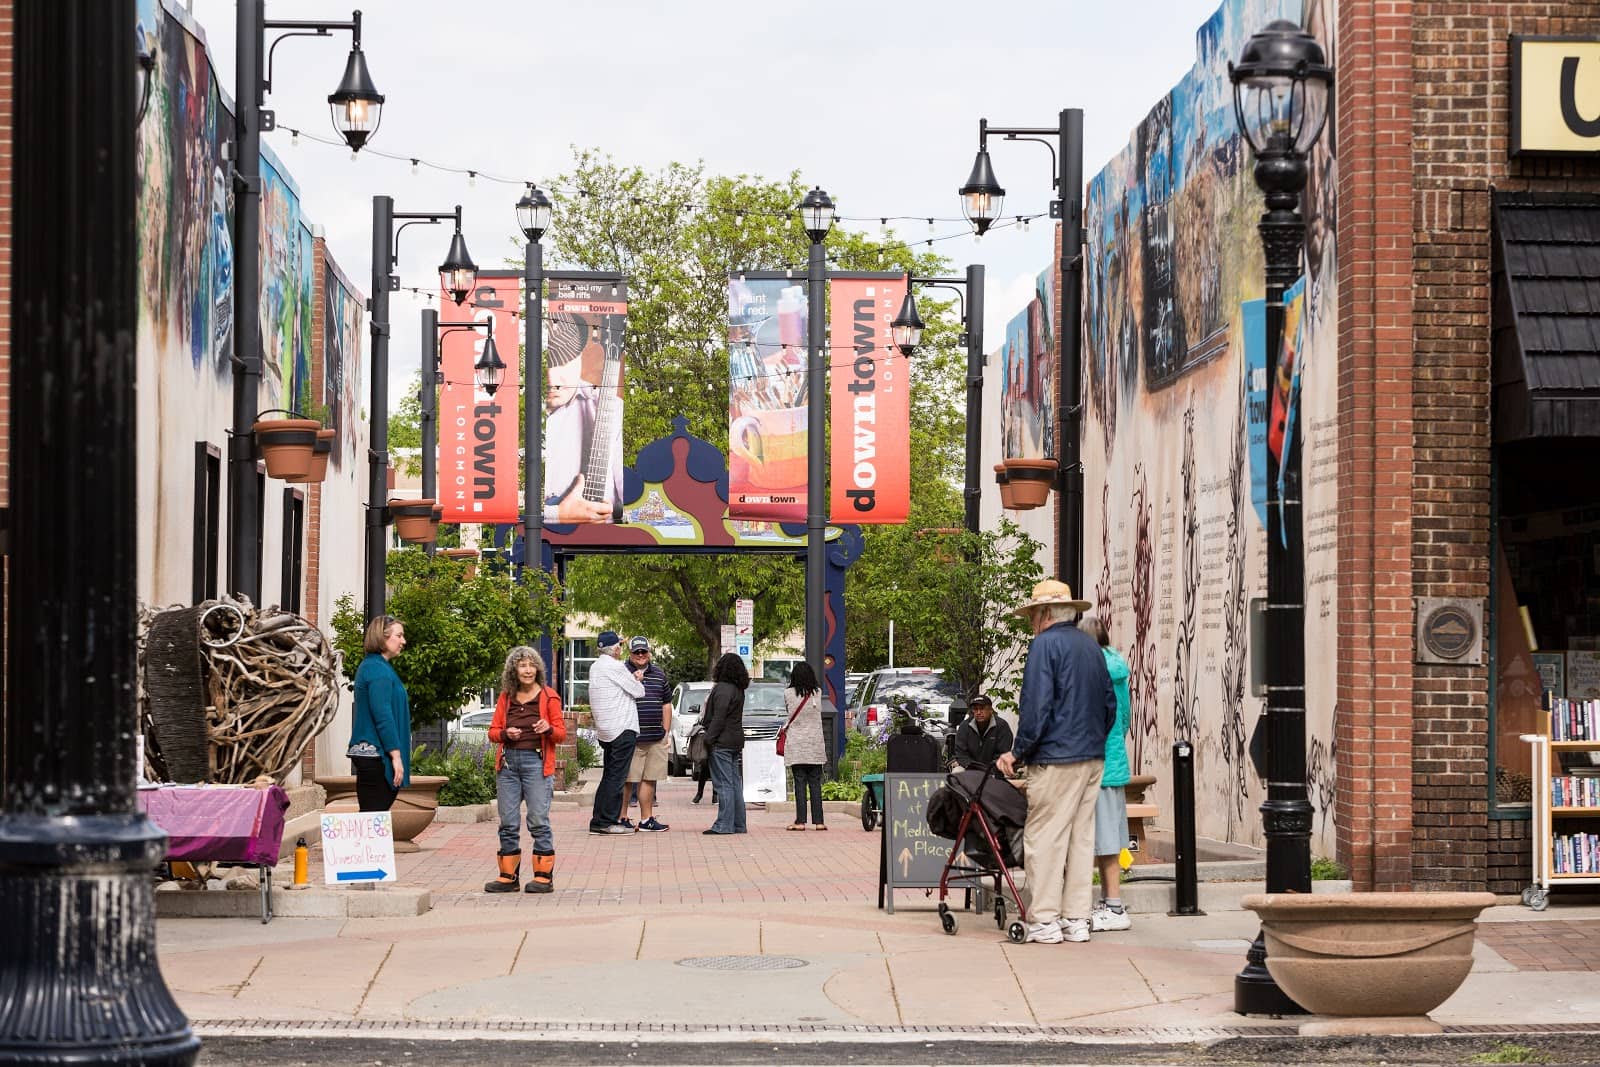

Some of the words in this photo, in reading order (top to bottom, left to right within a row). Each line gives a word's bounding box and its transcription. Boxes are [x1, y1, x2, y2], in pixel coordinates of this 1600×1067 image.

[590, 284, 602, 294] my
[456, 405, 466, 512] LONGMONT
[897, 779, 931, 800] Art
[914, 840, 954, 858] Place
